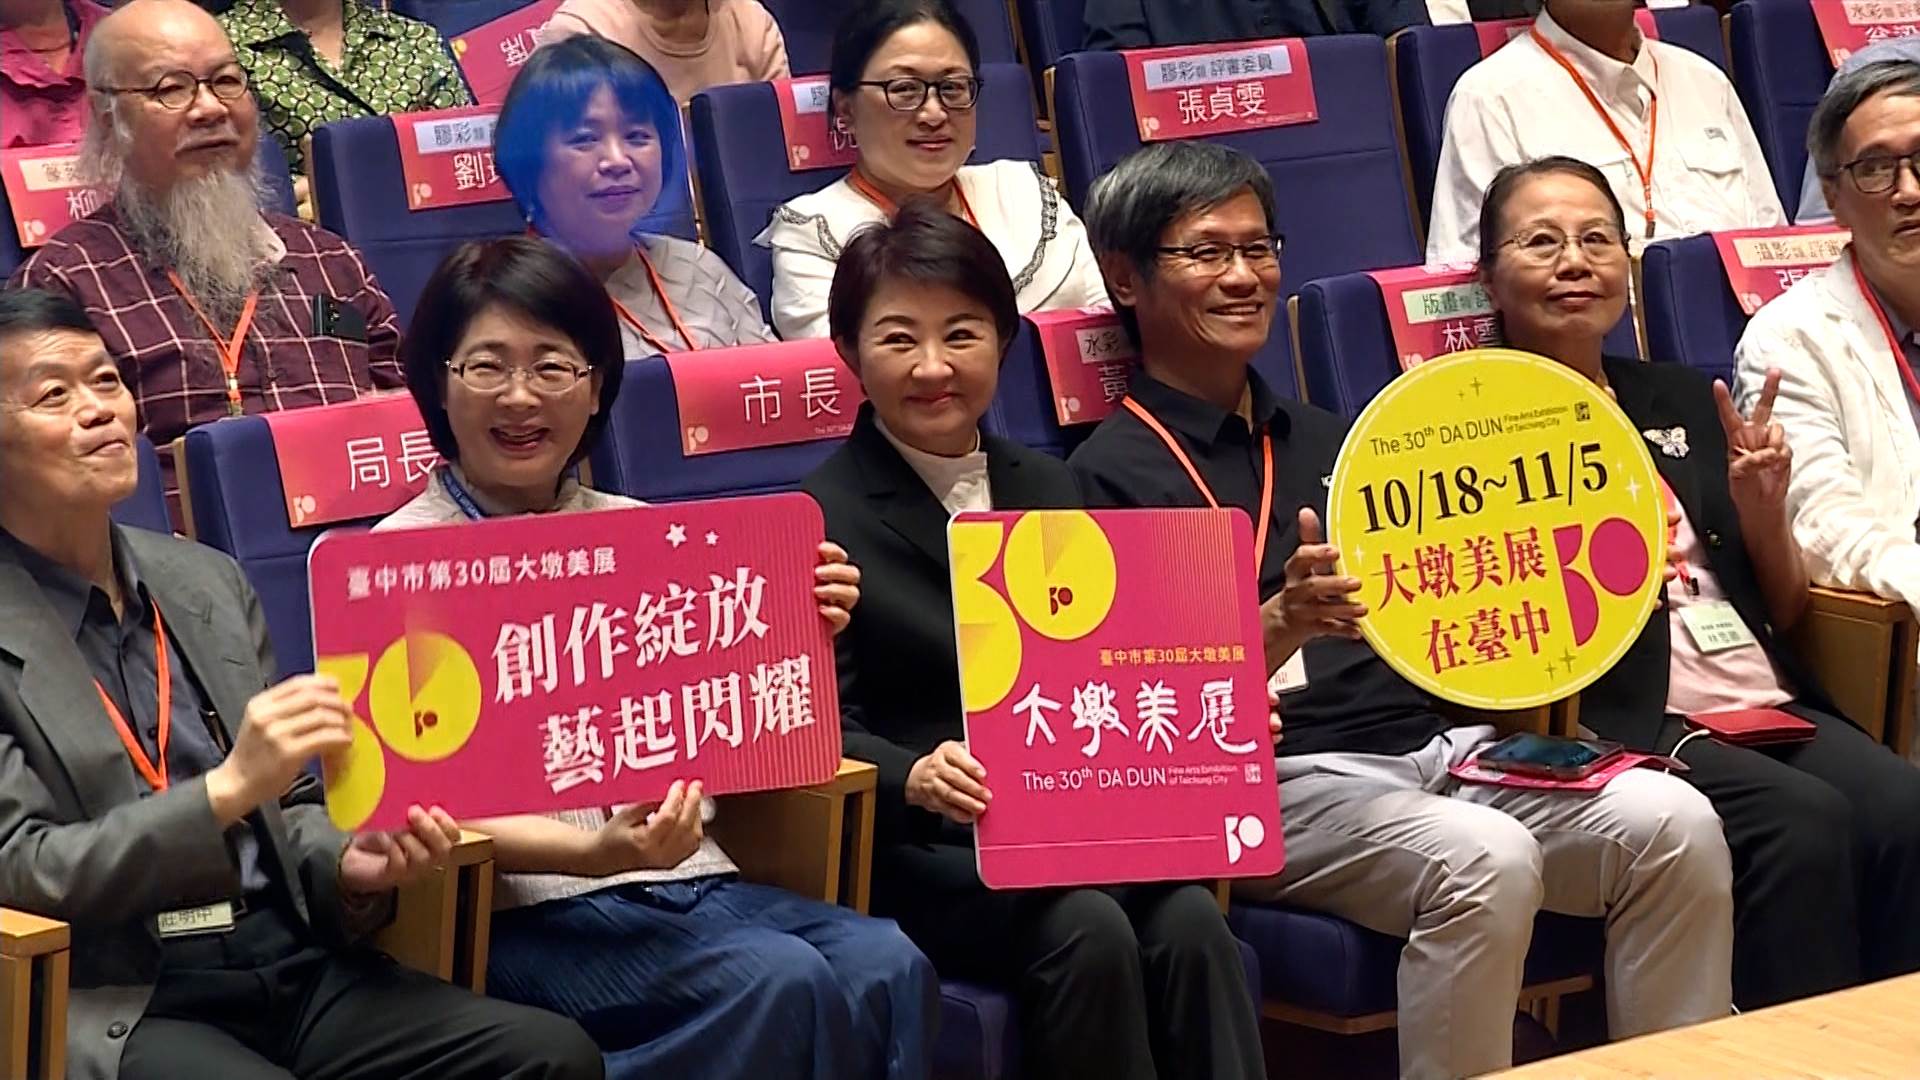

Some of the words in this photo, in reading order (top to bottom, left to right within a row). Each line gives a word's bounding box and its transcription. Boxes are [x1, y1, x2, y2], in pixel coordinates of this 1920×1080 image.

[1210, 53, 1273, 77] 評審委員
[1176, 80, 1268, 125] 張貞雯
[739, 366, 841, 425] 市長
[346, 429, 441, 491] 局長
[1369, 437, 1400, 456] The
[1403, 426, 1435, 451] 30th
[1439, 424, 1464, 444] DA
[1465, 417, 1504, 440] DUN
[1357, 441, 1608, 535] 10/18~11/5
[346, 545, 617, 601] 臺中市第30屆大墩美展
[1370, 526, 1548, 612] 大墩美展
[491, 566, 772, 705] 創作綻放
[1099, 645, 1246, 667] 臺中市第30屆大墩美展
[1422, 600, 1551, 675] 在臺中
[536, 653, 817, 795] 藝起閃耀
[1012, 677, 1258, 758] 大墩美展
[1022, 771, 1055, 791] The
[1058, 766, 1093, 790] 30th
[1098, 769, 1124, 788] DA
[1126, 767, 1167, 787] DUN
